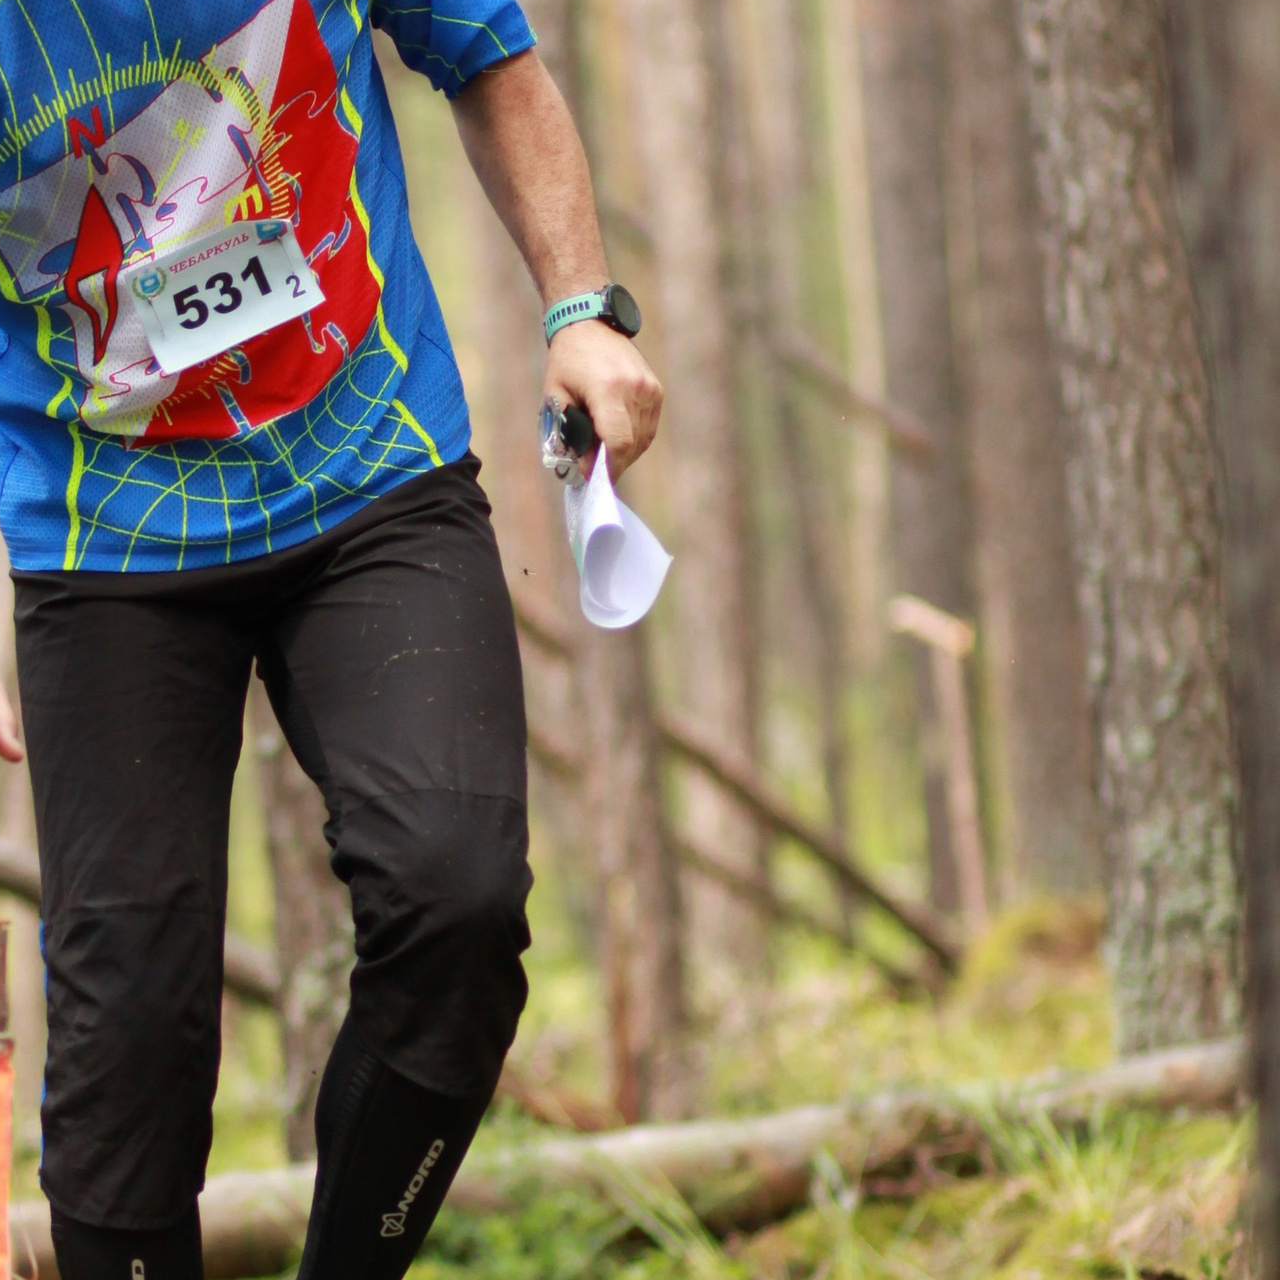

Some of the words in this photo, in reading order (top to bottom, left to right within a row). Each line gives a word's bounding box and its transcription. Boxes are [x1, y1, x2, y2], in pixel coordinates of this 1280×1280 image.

[68, 104, 106, 160] N
[168, 233, 250, 274] ЧЕБАРКУЛЬ
[172, 255, 272, 330] 531
[285, 274, 307, 298] 2
[397, 1139, 445, 1213] NORD
